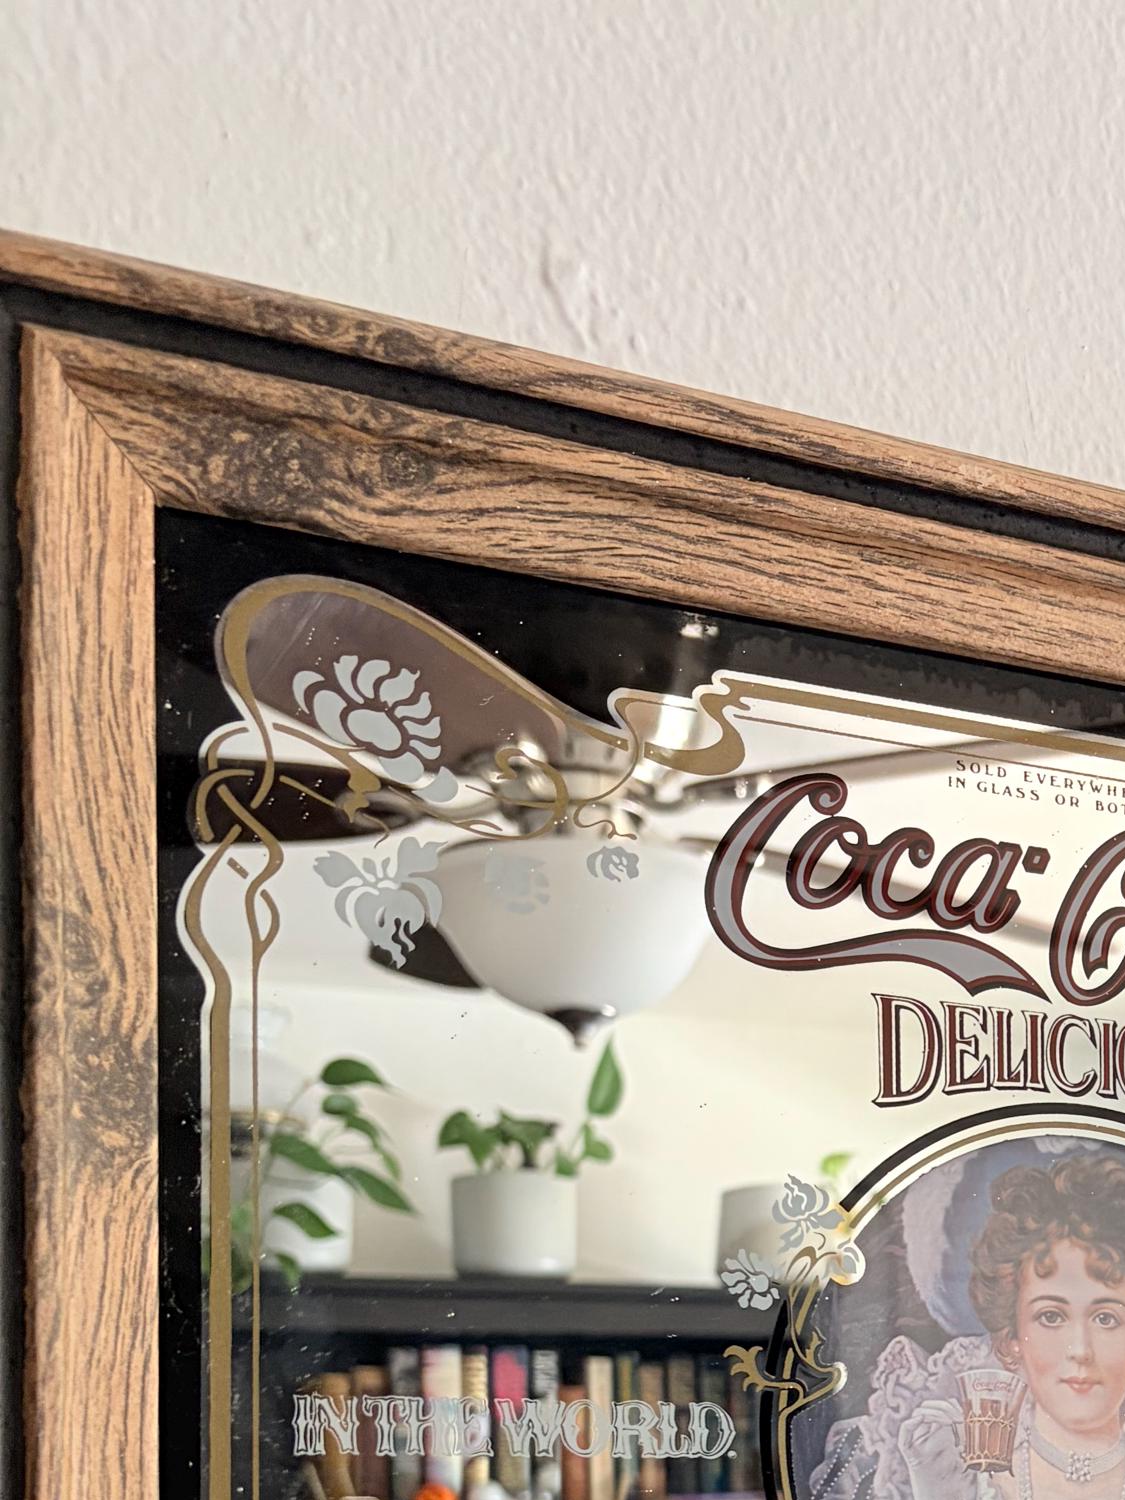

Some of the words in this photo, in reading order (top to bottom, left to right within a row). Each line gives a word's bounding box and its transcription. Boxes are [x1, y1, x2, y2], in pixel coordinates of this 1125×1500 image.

[956, 759, 1007, 778] SOLD
[948, 776, 966, 789] IN
[977, 781, 1040, 802] GLASS
[1054, 794, 1080, 808] OR
[293, 1394, 359, 1458] IN
[362, 1395, 494, 1459] THE
